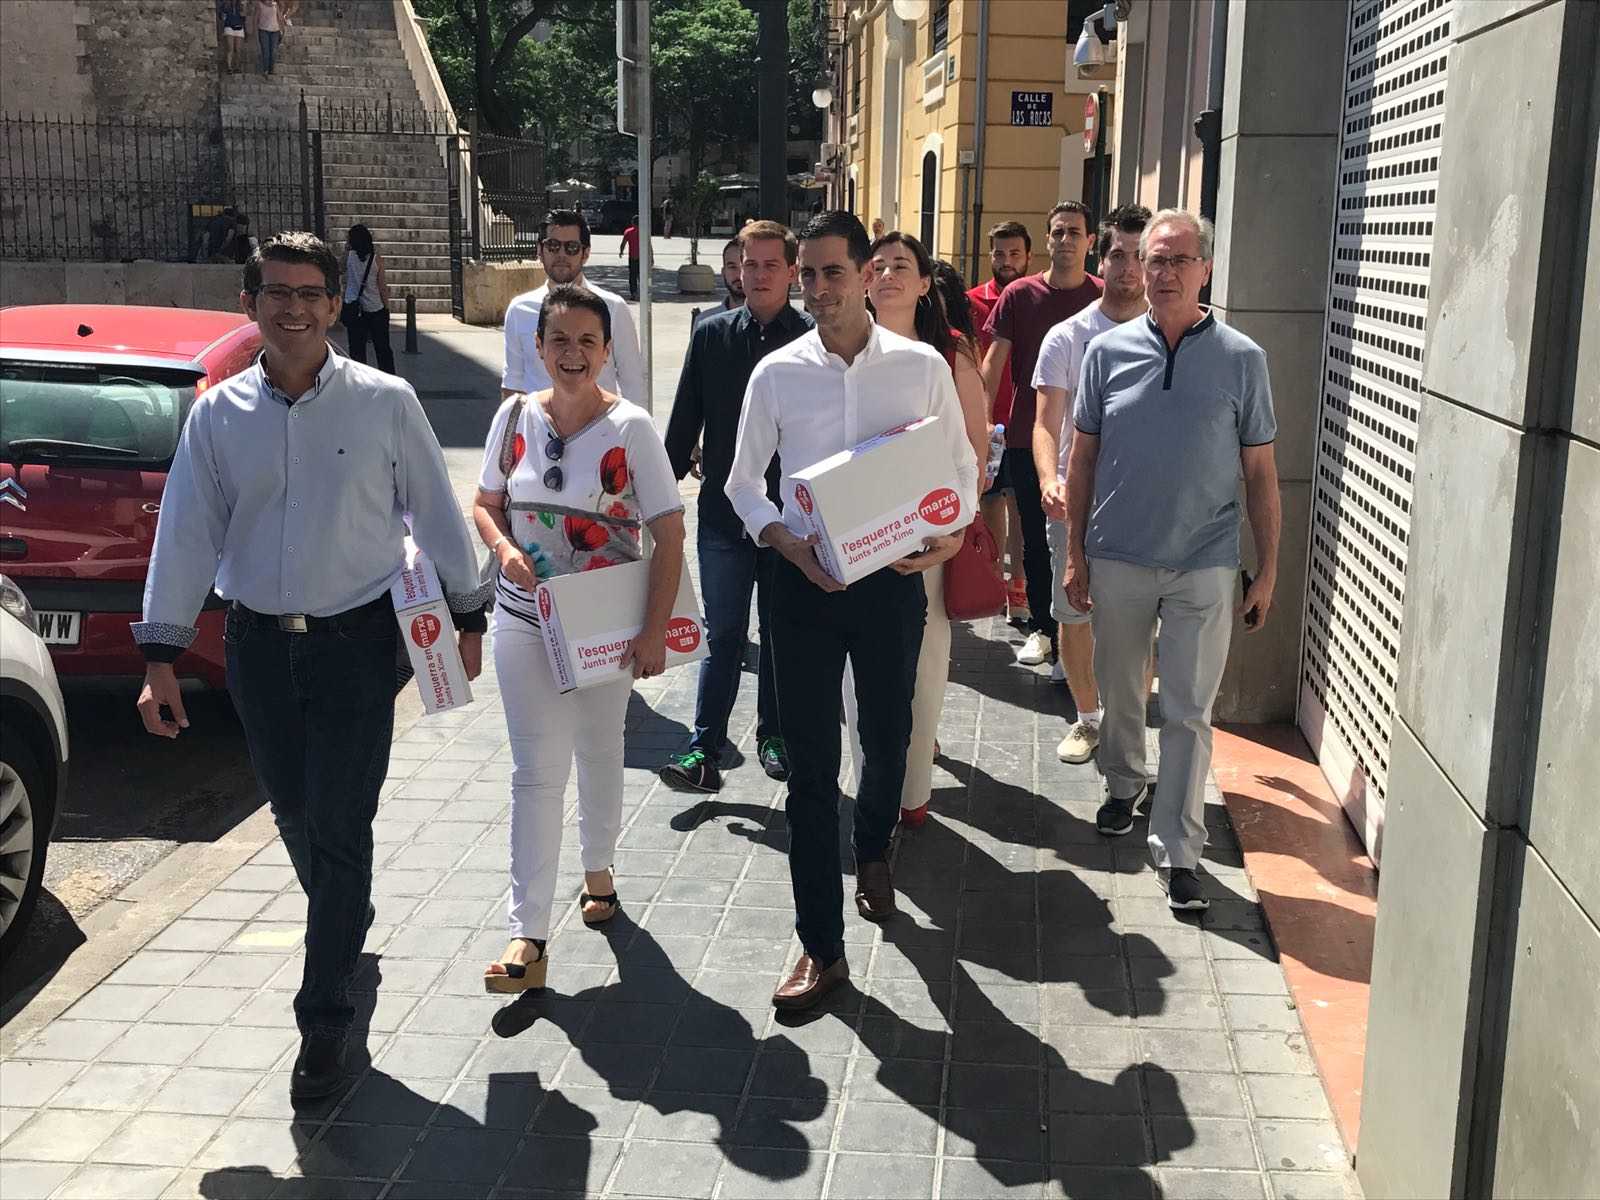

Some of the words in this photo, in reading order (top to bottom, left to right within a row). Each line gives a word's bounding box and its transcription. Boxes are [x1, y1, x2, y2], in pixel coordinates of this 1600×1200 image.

[1018, 94, 1047, 102] CALLE
[1012, 111, 1025, 125] LAS
[1030, 111, 1052, 125] ROCAS
[841, 520, 902, 555] l'esquerra
[903, 511, 919, 525] en
[920, 492, 958, 517] marxa
[848, 549, 872, 565] Junts
[872, 538, 891, 553] amb
[892, 528, 914, 544] Ximo
[578, 639, 632, 660] l'esquerr
[582, 658, 606, 670] Junts
